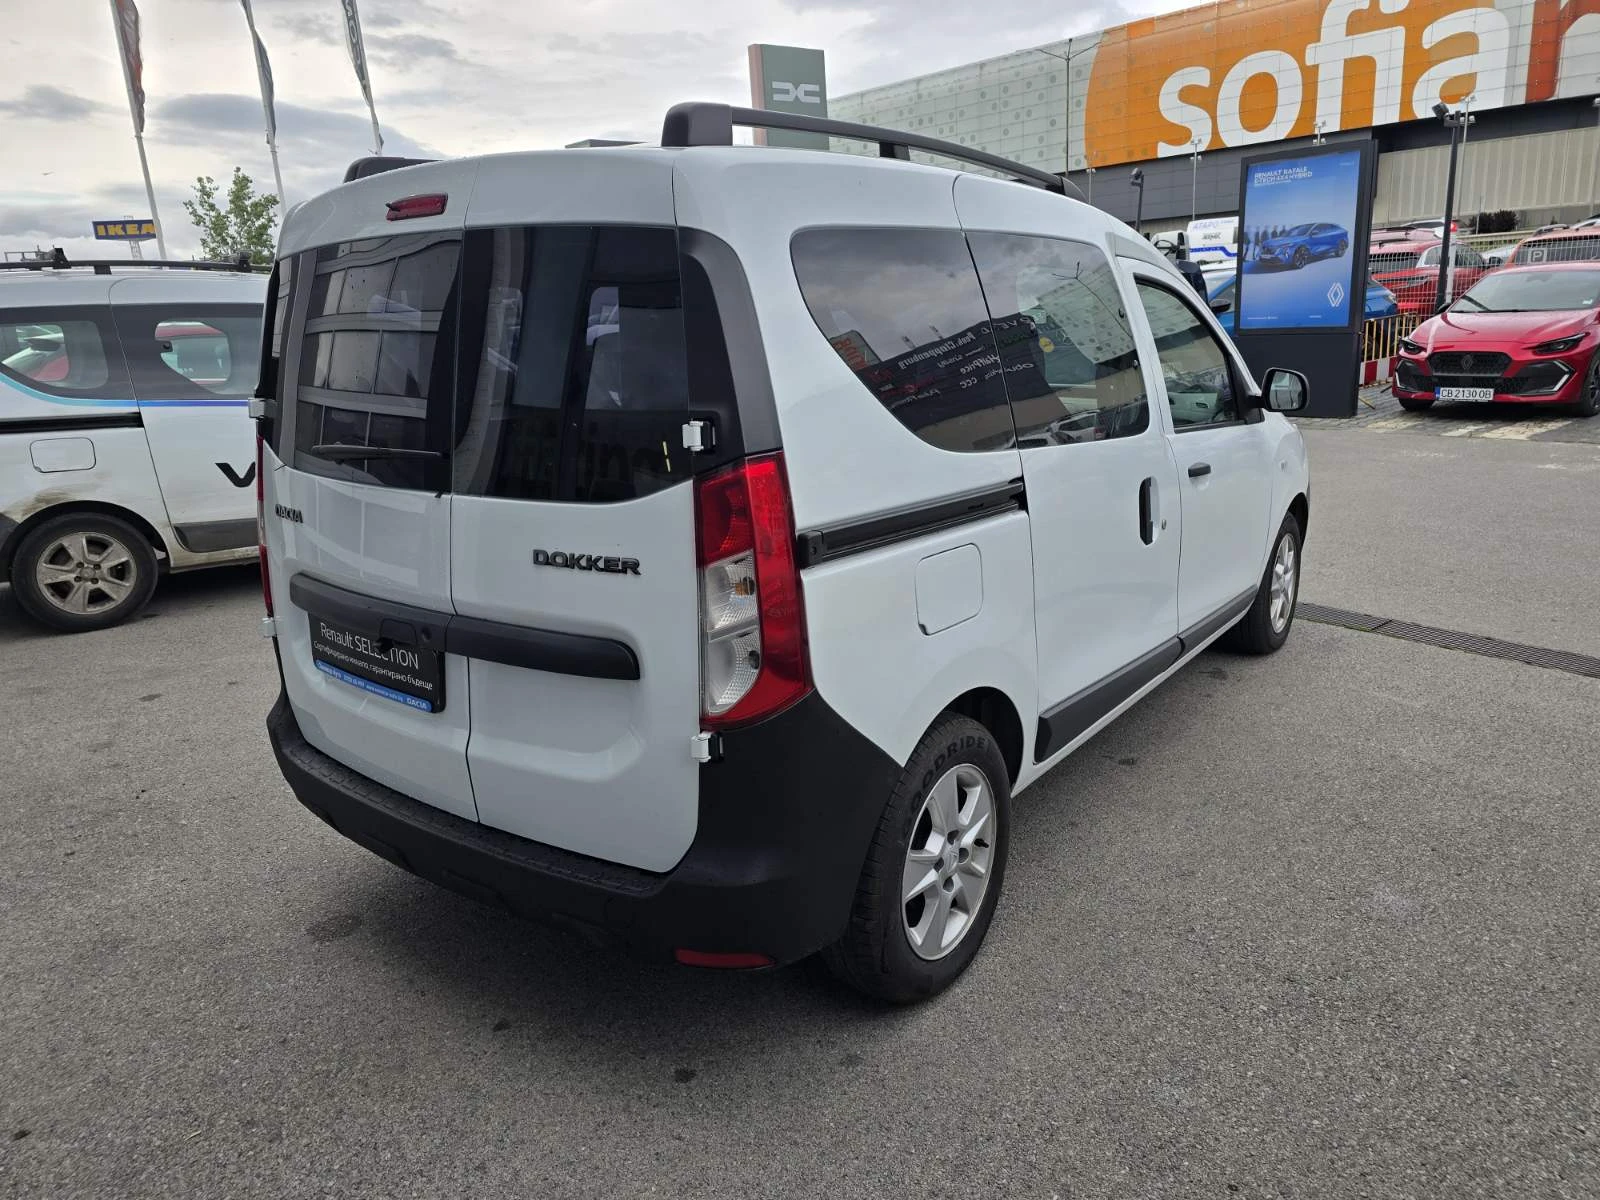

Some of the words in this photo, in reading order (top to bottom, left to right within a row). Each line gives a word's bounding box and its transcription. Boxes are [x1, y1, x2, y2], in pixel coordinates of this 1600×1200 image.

[97, 223, 156, 236] IKEA
[1441, 389, 1453, 398] CB
[1454, 389, 1478, 398] 2130
[532, 549, 641, 576] DOKKER
[320, 622, 354, 650] Renault
[354, 635, 419, 670] SELTION
